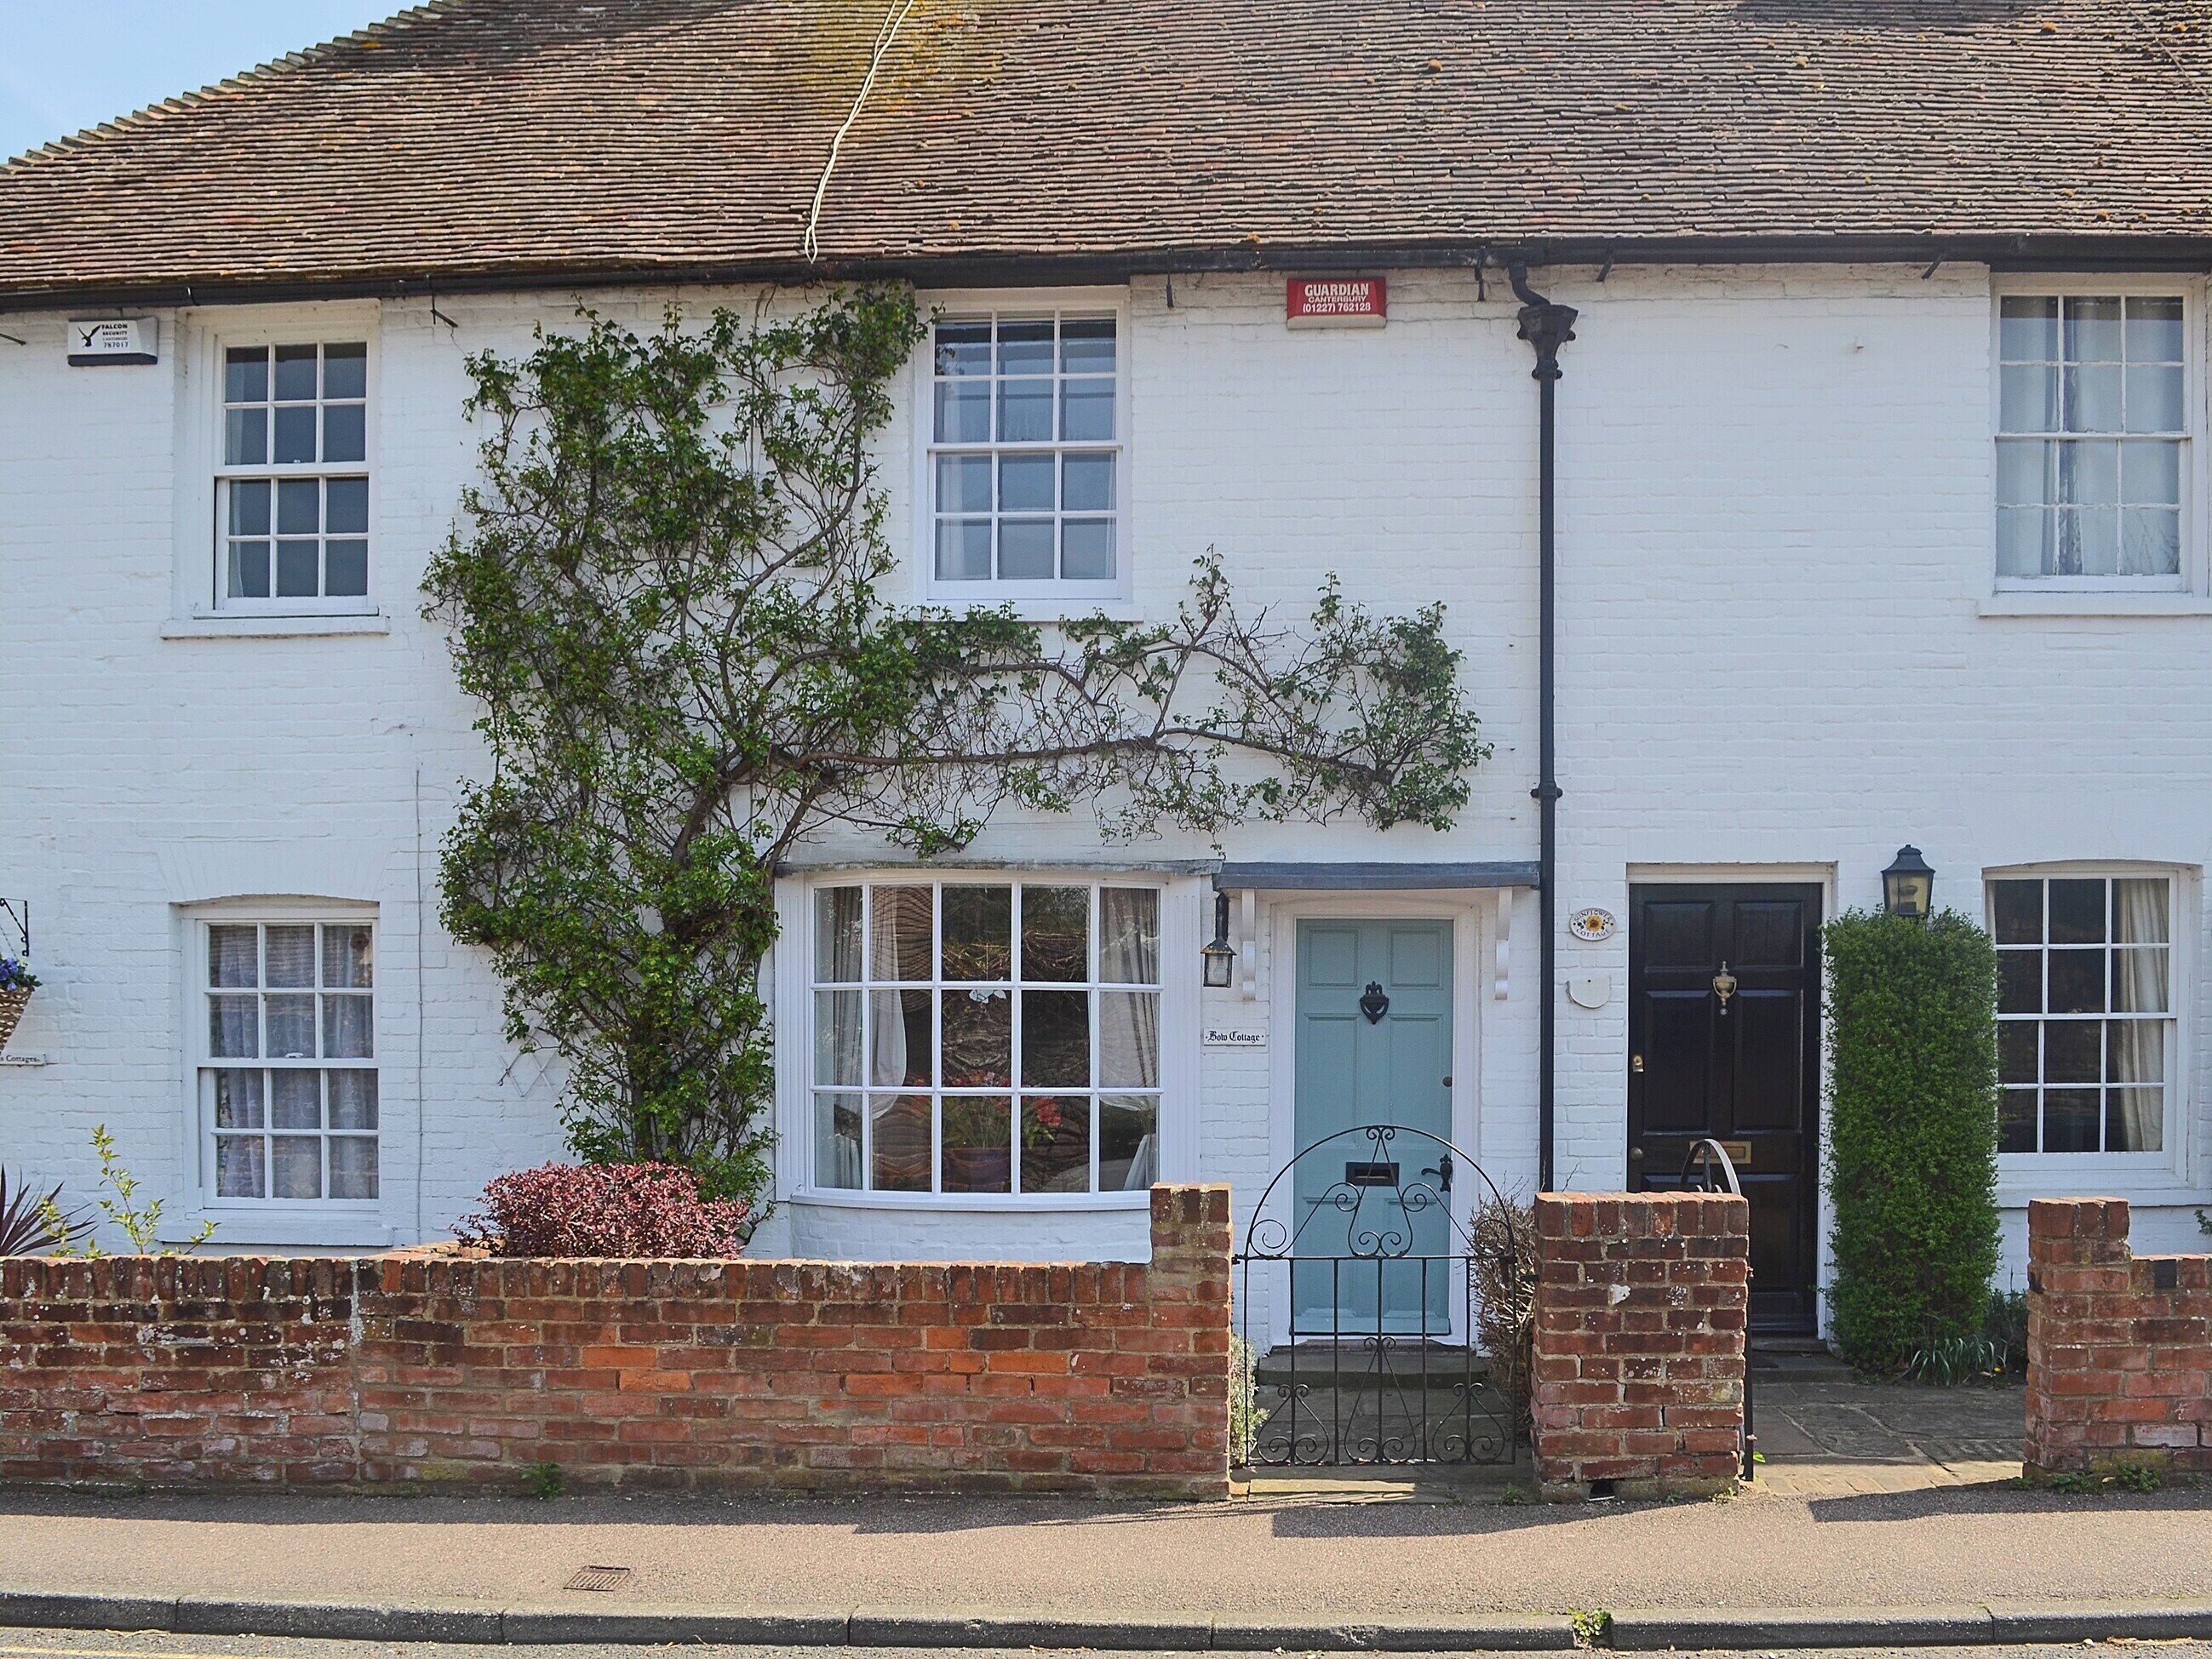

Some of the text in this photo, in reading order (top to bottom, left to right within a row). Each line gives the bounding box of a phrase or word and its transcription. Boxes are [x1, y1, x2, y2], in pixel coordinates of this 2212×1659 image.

[1304, 283, 1369, 297] GUARDIAN
[1303, 302, 1371, 313] (01227) 762128
[1207, 1030, 1260, 1044] Bow Cottage
